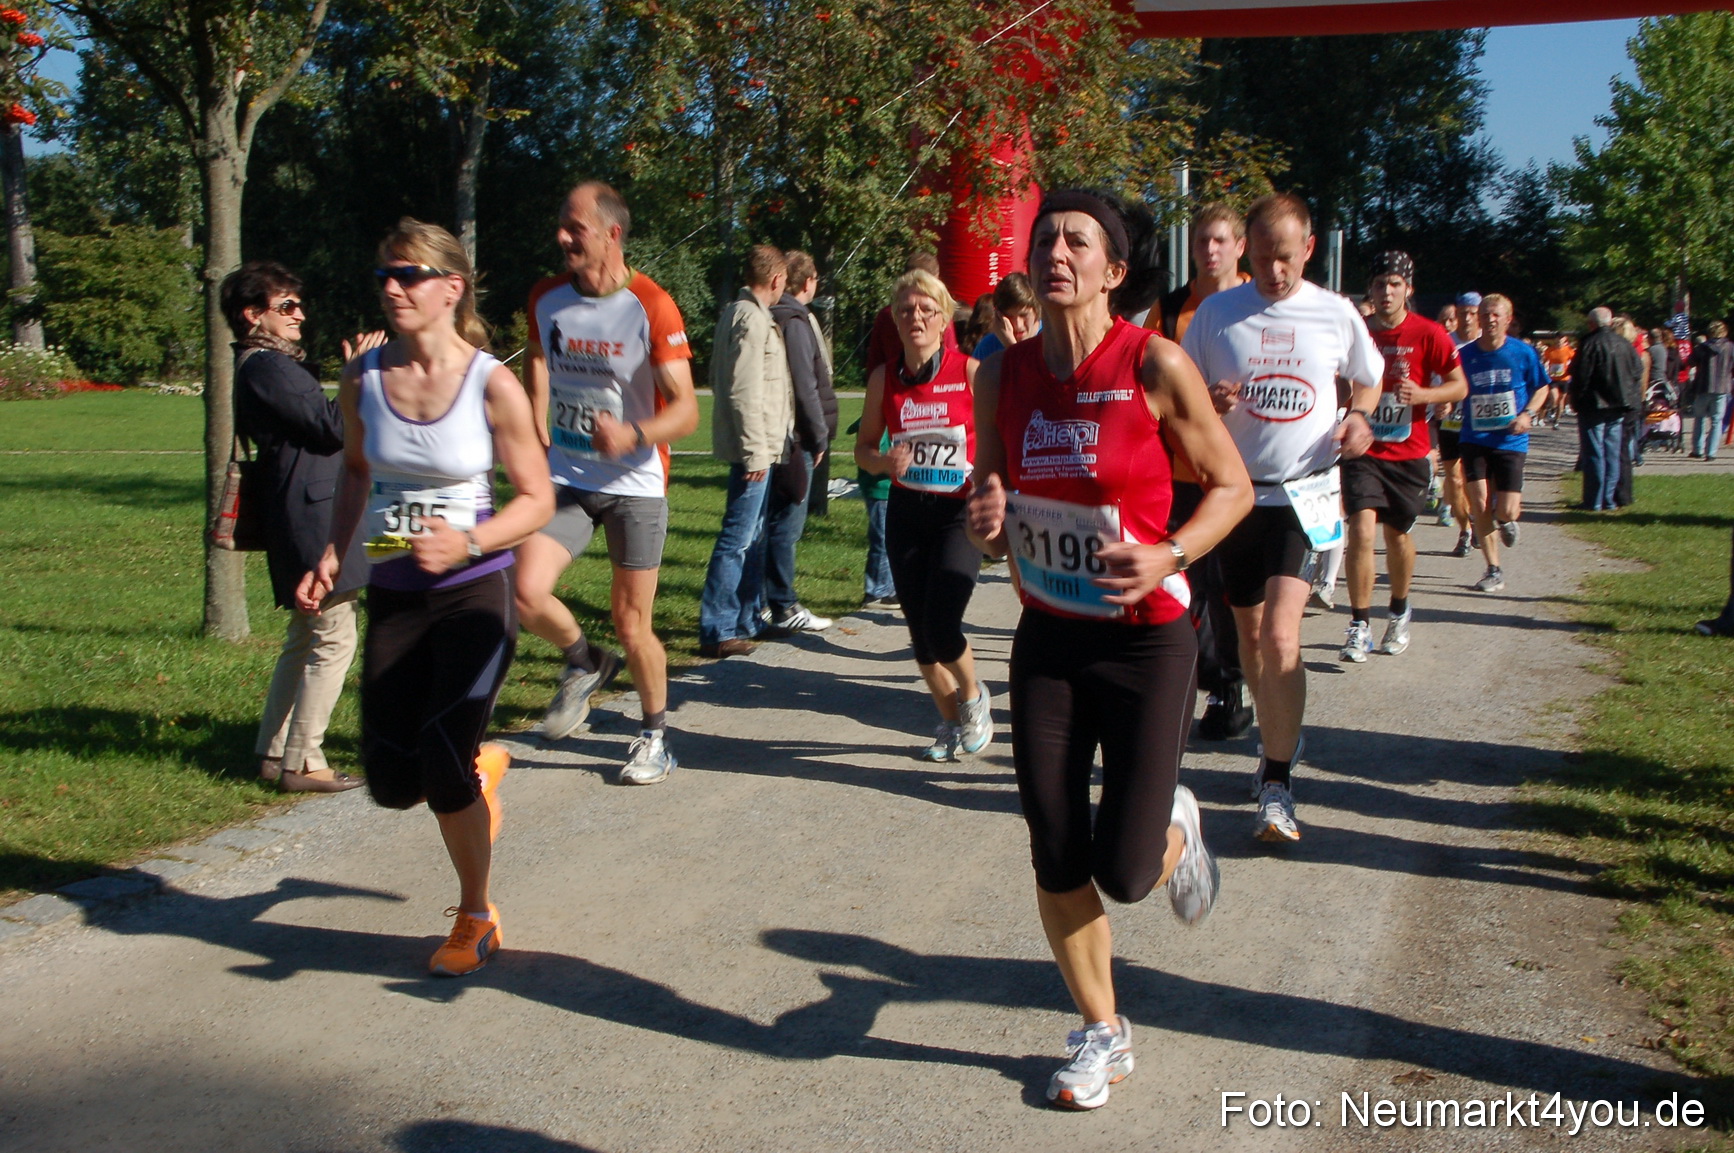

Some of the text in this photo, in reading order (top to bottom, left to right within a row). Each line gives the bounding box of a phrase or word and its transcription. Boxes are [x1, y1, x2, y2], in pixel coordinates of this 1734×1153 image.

[566, 338, 625, 358] MERZ
[1248, 357, 1304, 367] SEAT
[556, 402, 612, 434] 275
[1474, 402, 1511, 418] 2958
[938, 469, 964, 482] Ma-
[1018, 521, 1106, 574] 3198
[1042, 570, 1080, 598] Irmi
